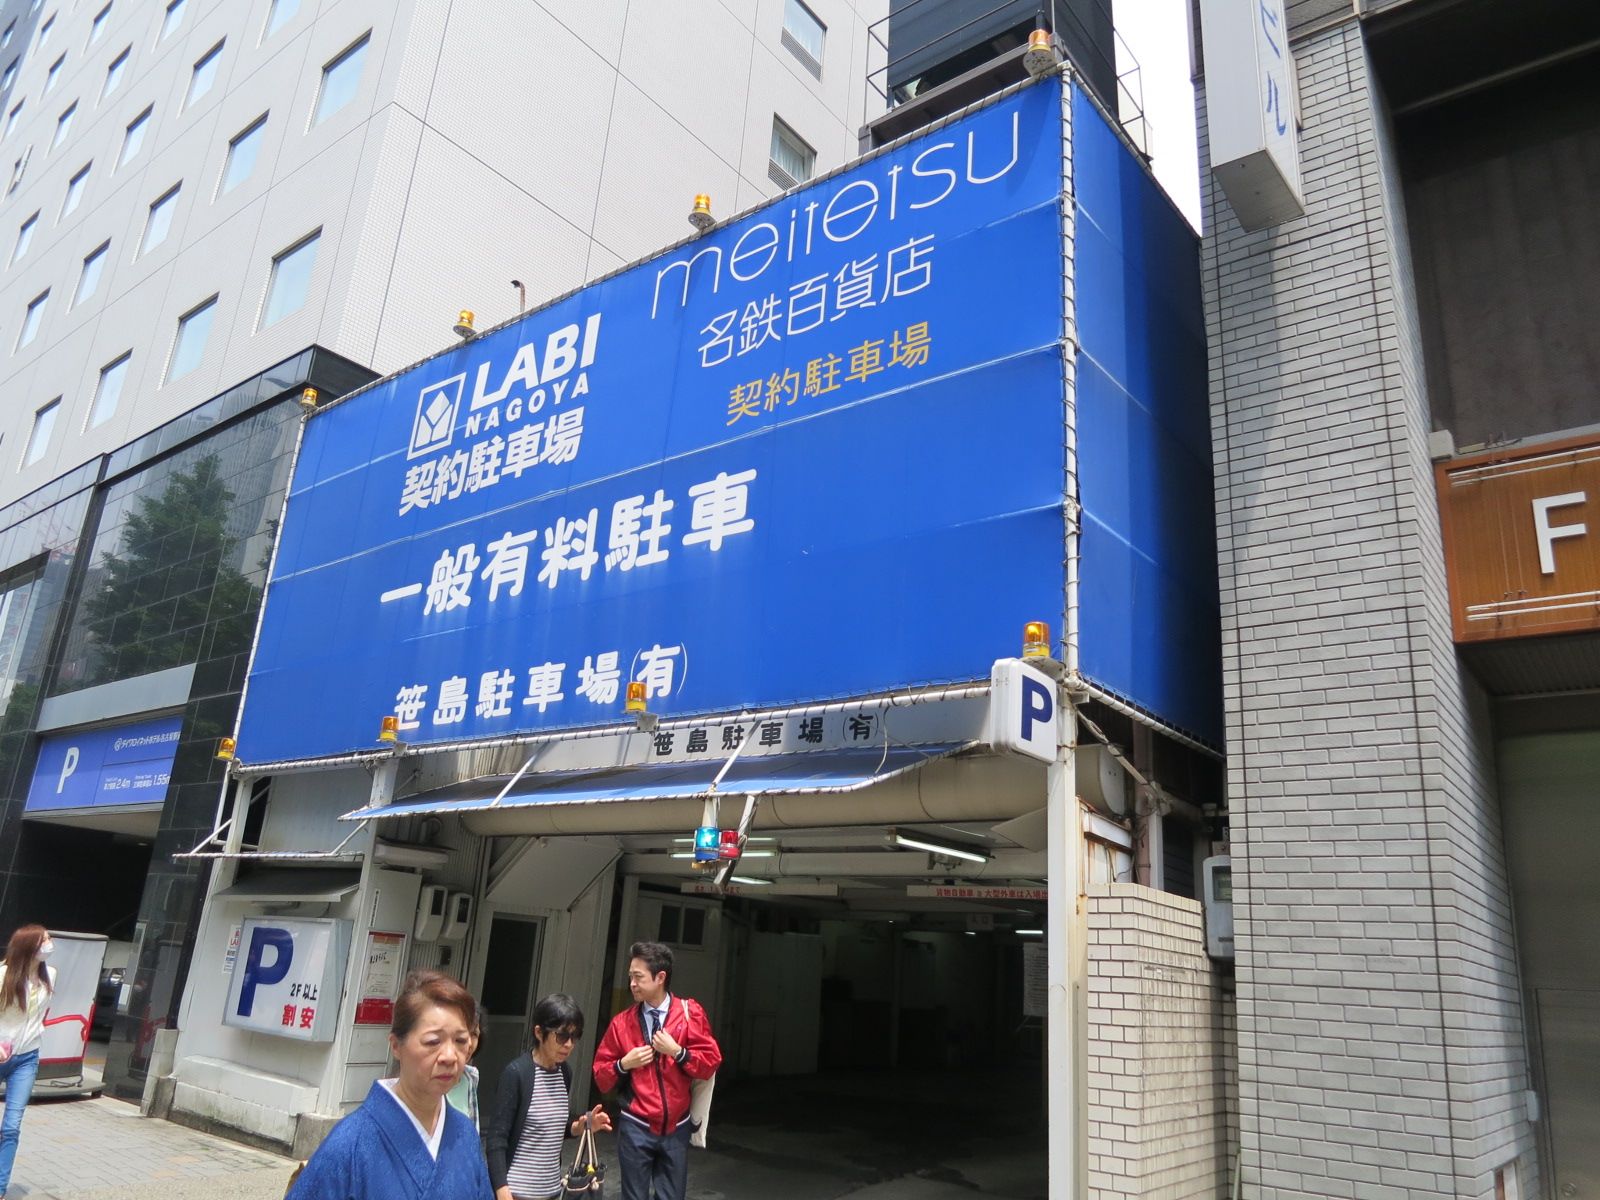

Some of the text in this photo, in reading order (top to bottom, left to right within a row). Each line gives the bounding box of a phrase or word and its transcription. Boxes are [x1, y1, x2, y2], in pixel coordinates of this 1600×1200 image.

[652, 111, 1019, 319] meitetsu
[698, 233, 935, 367] 名鉄百貨店
[464, 372, 589, 438] NAGOYA
[469, 312, 602, 412] LABI
[726, 321, 932, 426] 契約駐車場
[398, 406, 585, 517] 契約駐車場
[380, 468, 757, 616] 一般有料駐車
[1532, 491, 1587, 574] F
[1020, 674, 1053, 742] P
[56, 746, 80, 794] P
[237, 926, 294, 1017] P
[281, 1004, 315, 1029] 割安
